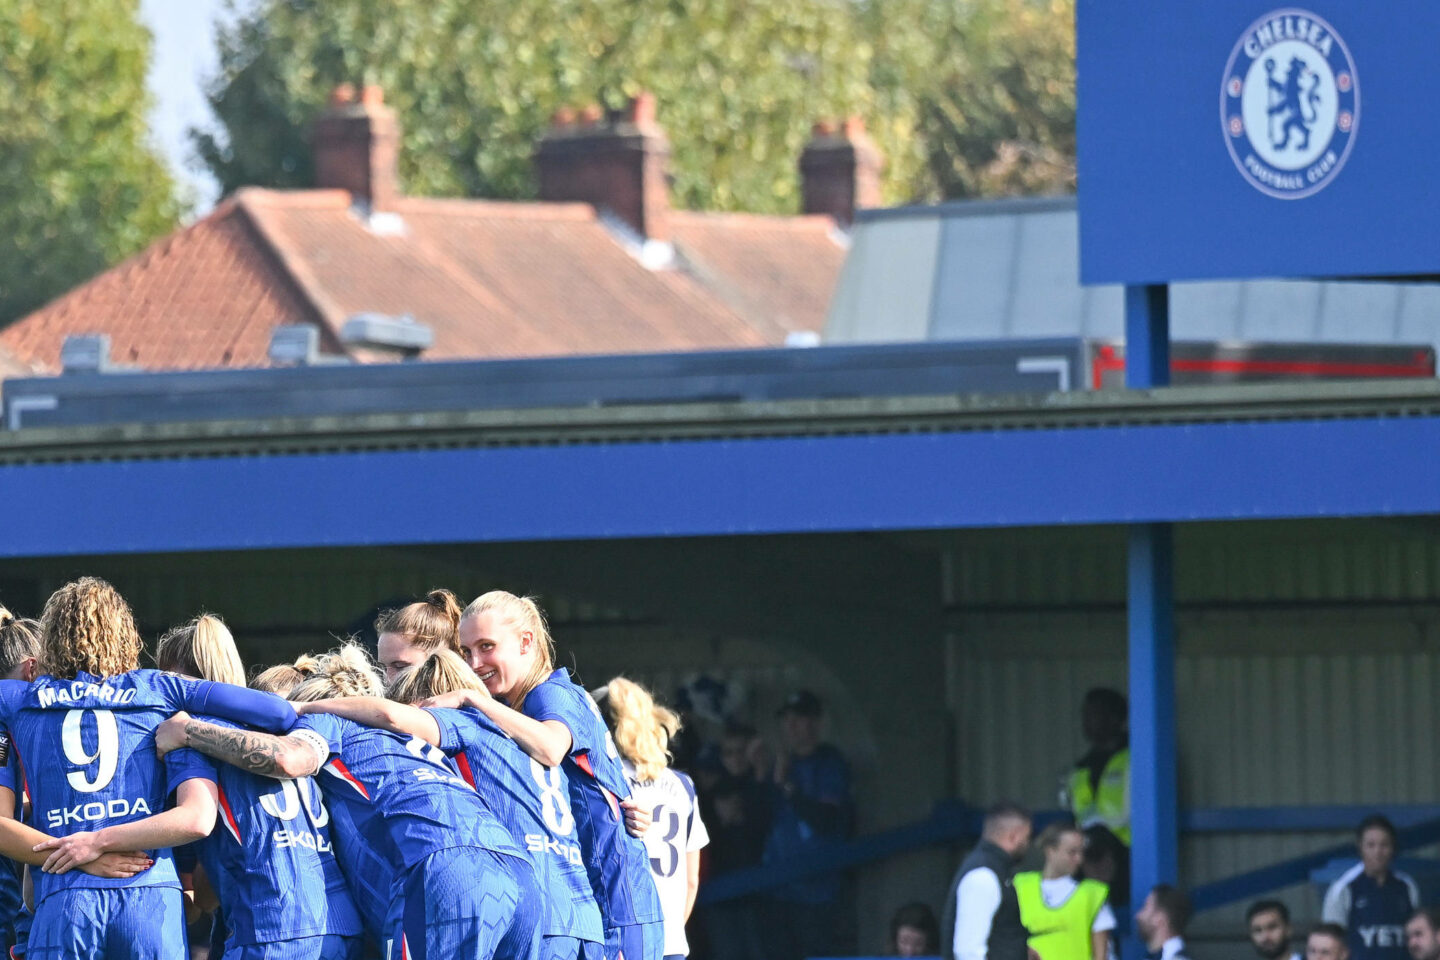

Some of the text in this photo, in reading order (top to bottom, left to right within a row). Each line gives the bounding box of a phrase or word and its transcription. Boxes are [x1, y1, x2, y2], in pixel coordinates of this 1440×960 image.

[1244, 15, 1334, 60] CHELSEA
[61, 708, 120, 794] 9
[530, 756, 574, 837] 8
